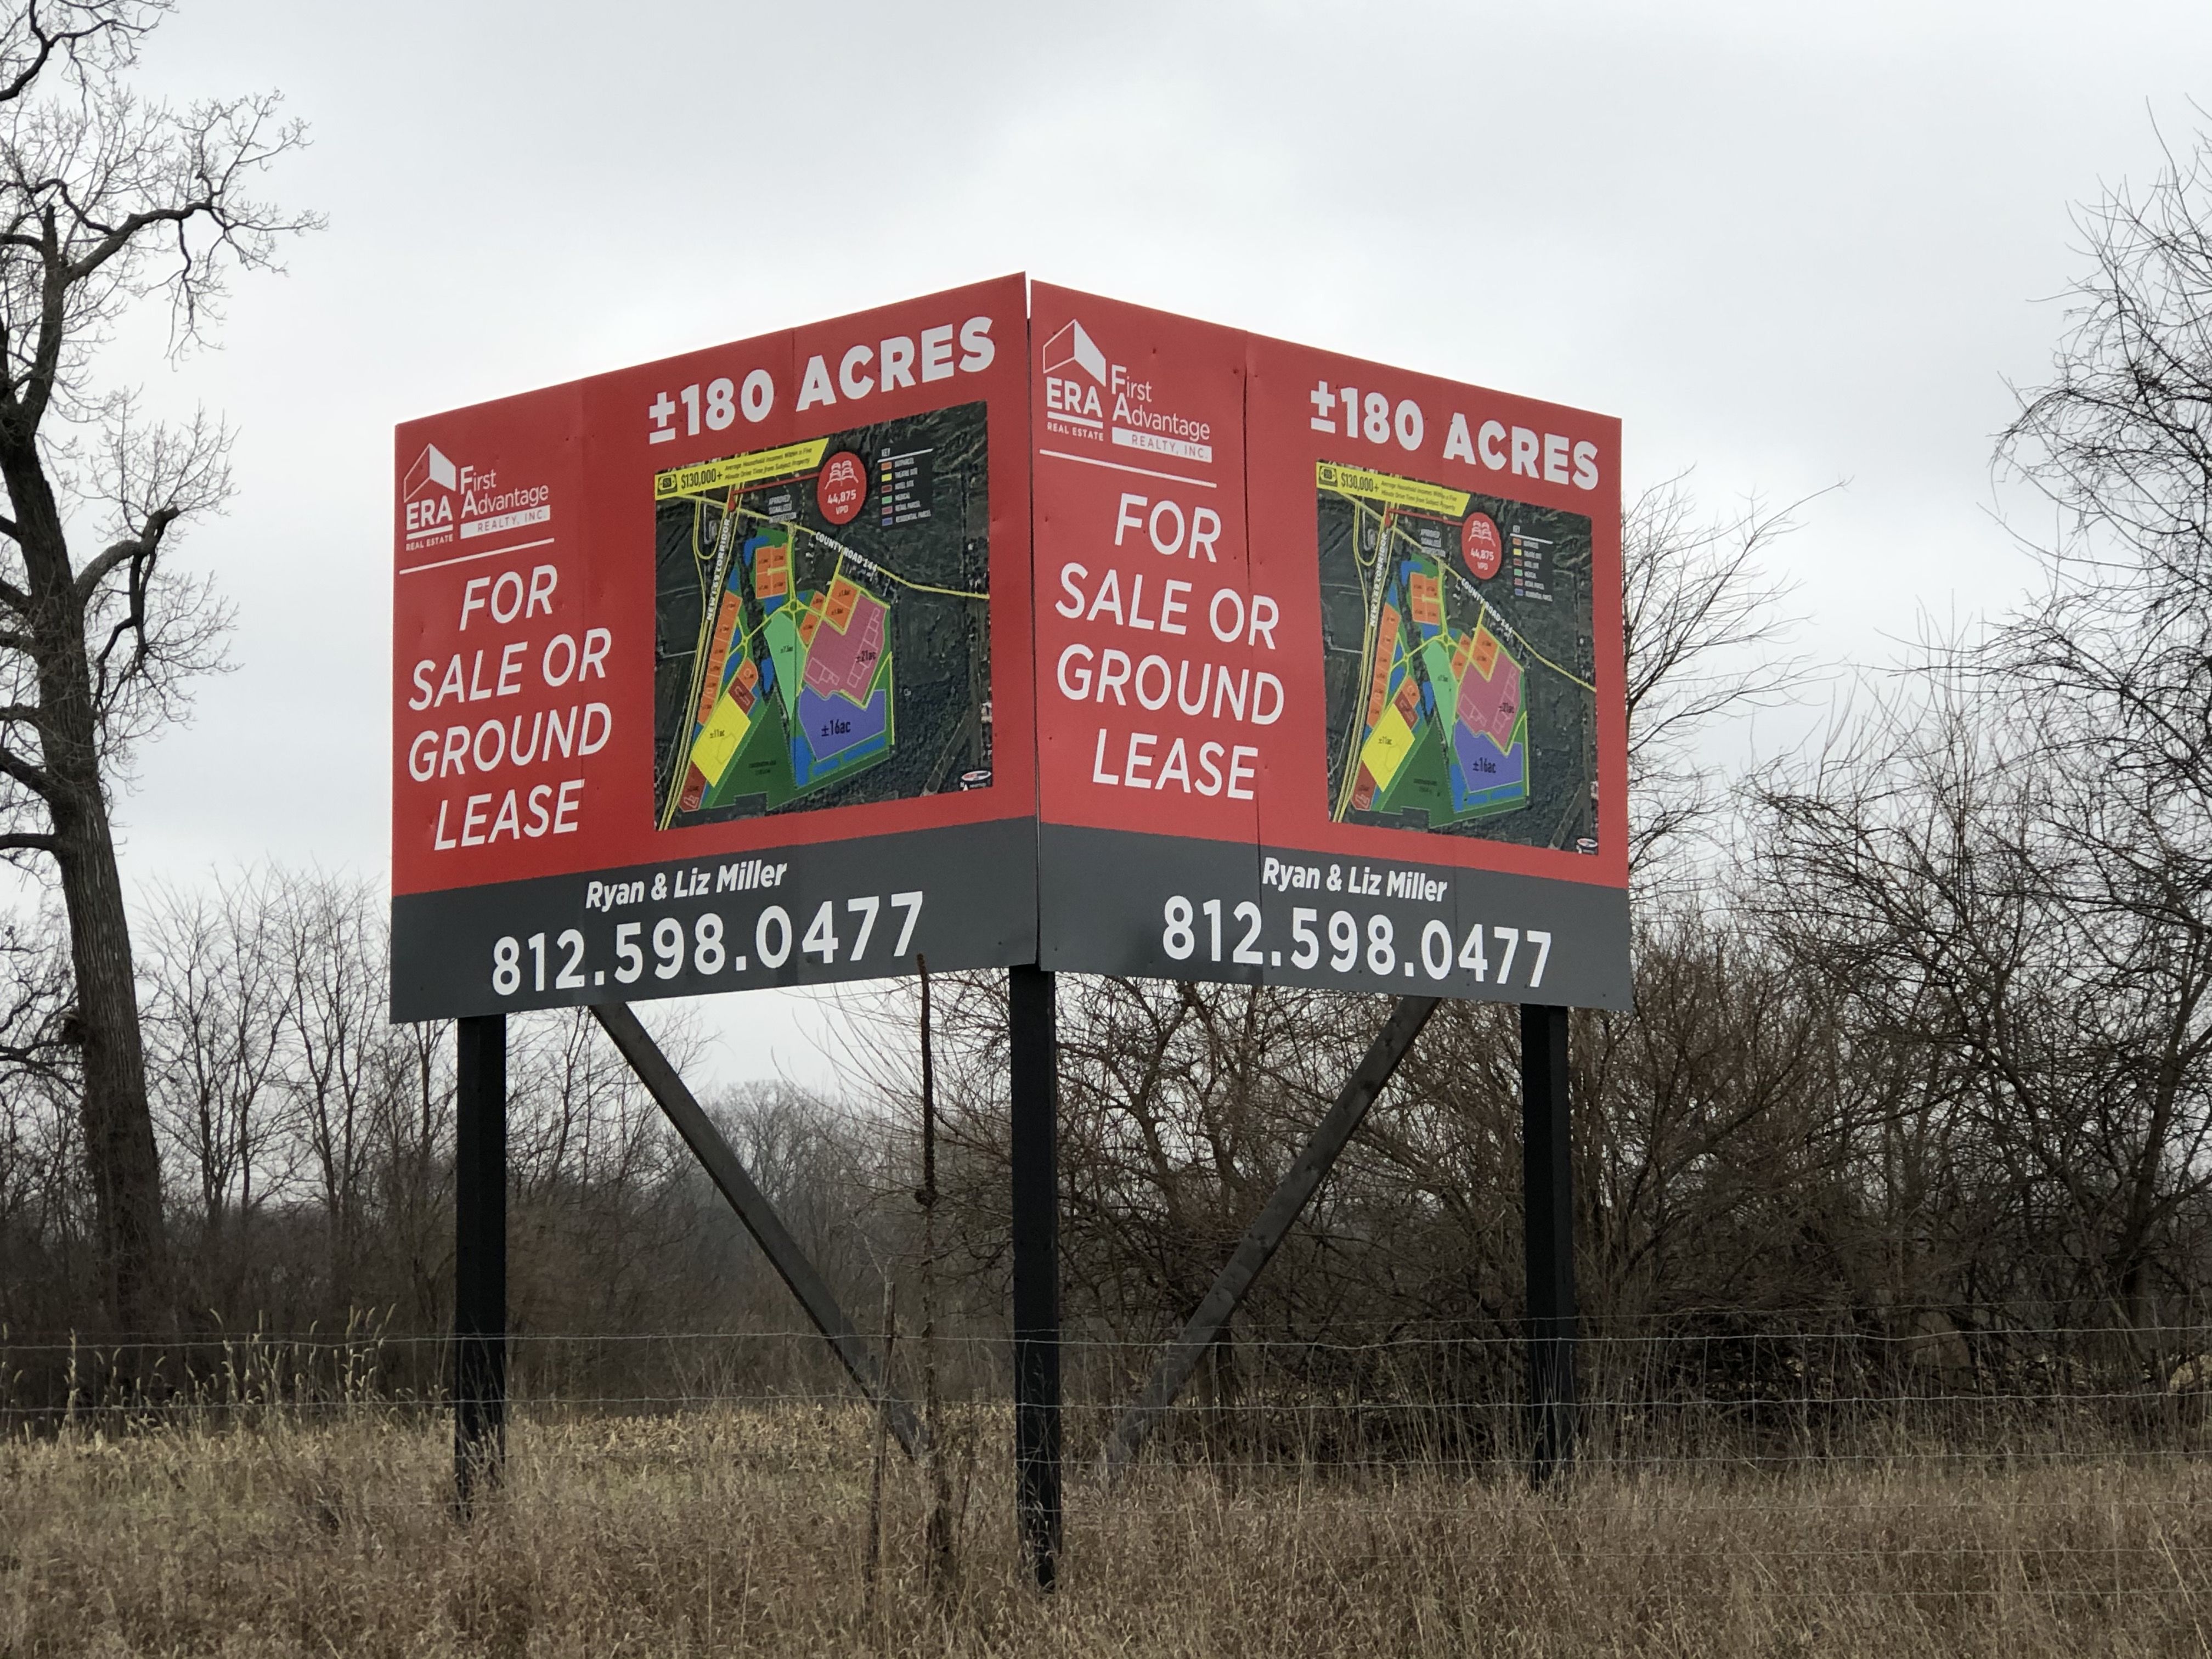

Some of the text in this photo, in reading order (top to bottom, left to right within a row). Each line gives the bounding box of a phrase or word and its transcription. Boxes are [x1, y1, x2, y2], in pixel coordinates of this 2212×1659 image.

[649, 316, 996, 445] ±180 ACRES
[1046, 376, 1103, 418] ERA
[1111, 364, 1152, 402] First
[1047, 422, 1104, 441] REAL ESTATE
[1112, 392, 1210, 442] Advantage
[1310, 380, 1599, 490] ±180 ACRES
[1131, 434, 1209, 459] REALTY, INC.
[460, 465, 496, 495] First
[460, 484, 549, 518] Advantage
[827, 489, 856, 505] 44,875
[406, 495, 453, 531] ERA
[477, 510, 546, 533] REALTY, INC.
[836, 505, 849, 515] VPD
[1114, 492, 1221, 563] FOR
[405, 534, 453, 551] REAL ESTATE
[815, 532, 878, 572] COUNTY ROAD 144
[1376, 532, 1388, 582] CORRIDOR
[1470, 548, 1494, 561] 44,875
[706, 597, 715, 621] NEW
[714, 518, 731, 572] CORRIDOR
[459, 564, 558, 631] FOR
[1055, 562, 1279, 650] SALE OR
[1461, 578, 1485, 604] COUNTY
[1485, 601, 1501, 622] ROAD
[408, 627, 612, 712] SALE OR
[1057, 643, 1284, 725] GROUND
[408, 702, 612, 782] GROUND
[821, 719, 851, 737] ±16ac
[1092, 728, 1259, 800] LEASE
[1472, 757, 1497, 774] ±16ac
[433, 778, 585, 851] LEASE
[585, 859, 788, 912] Ryan & Liz Miller
[1262, 857, 1448, 902] Ryan & Liz Miller
[492, 890, 924, 997] 812.598.0477
[1162, 895, 1552, 988] 812.598.0477
